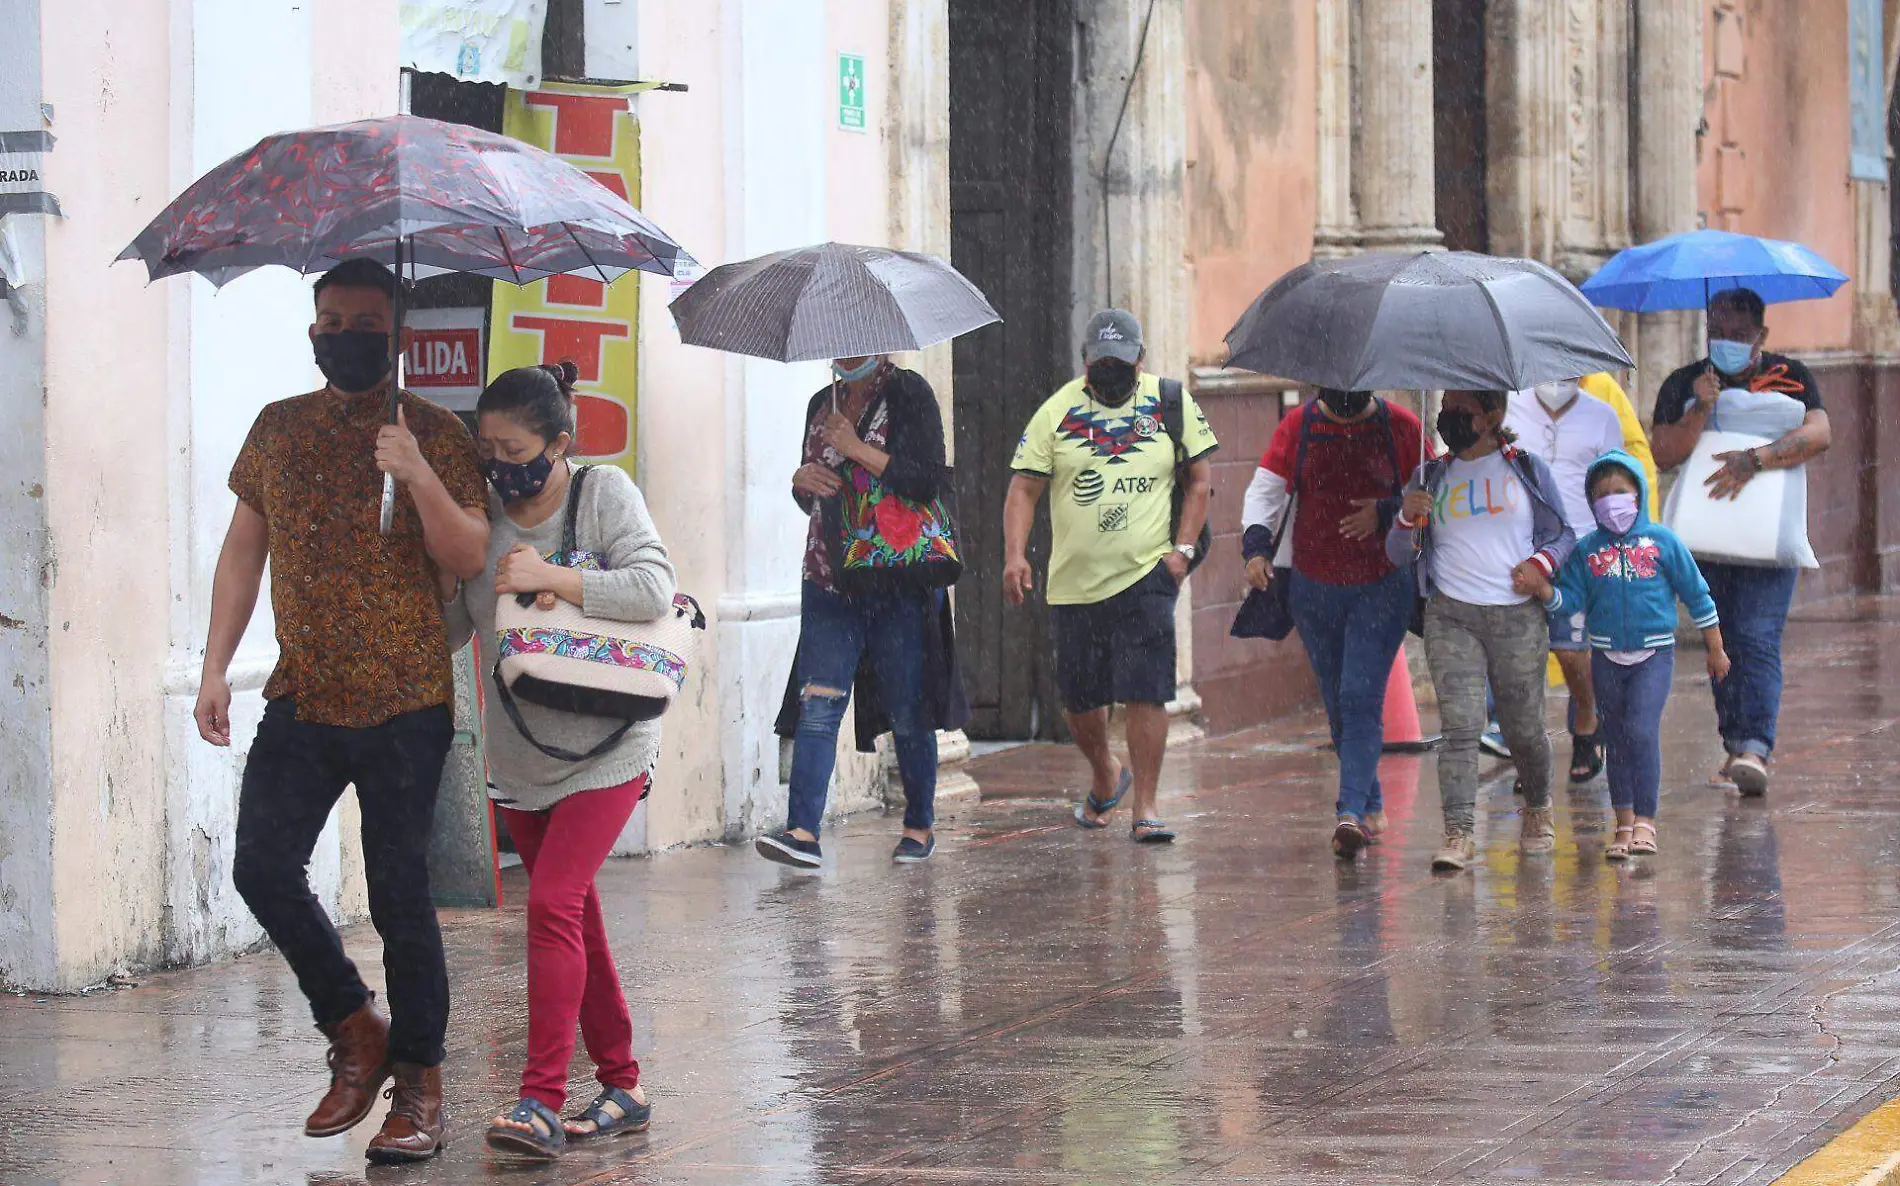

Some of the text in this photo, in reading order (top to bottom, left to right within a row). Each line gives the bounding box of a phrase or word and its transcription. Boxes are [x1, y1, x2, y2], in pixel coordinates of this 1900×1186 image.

[1112, 477, 1158, 494] AT&T
[1430, 475, 1517, 525] HELLO
[1587, 545, 1660, 577] LOVE
